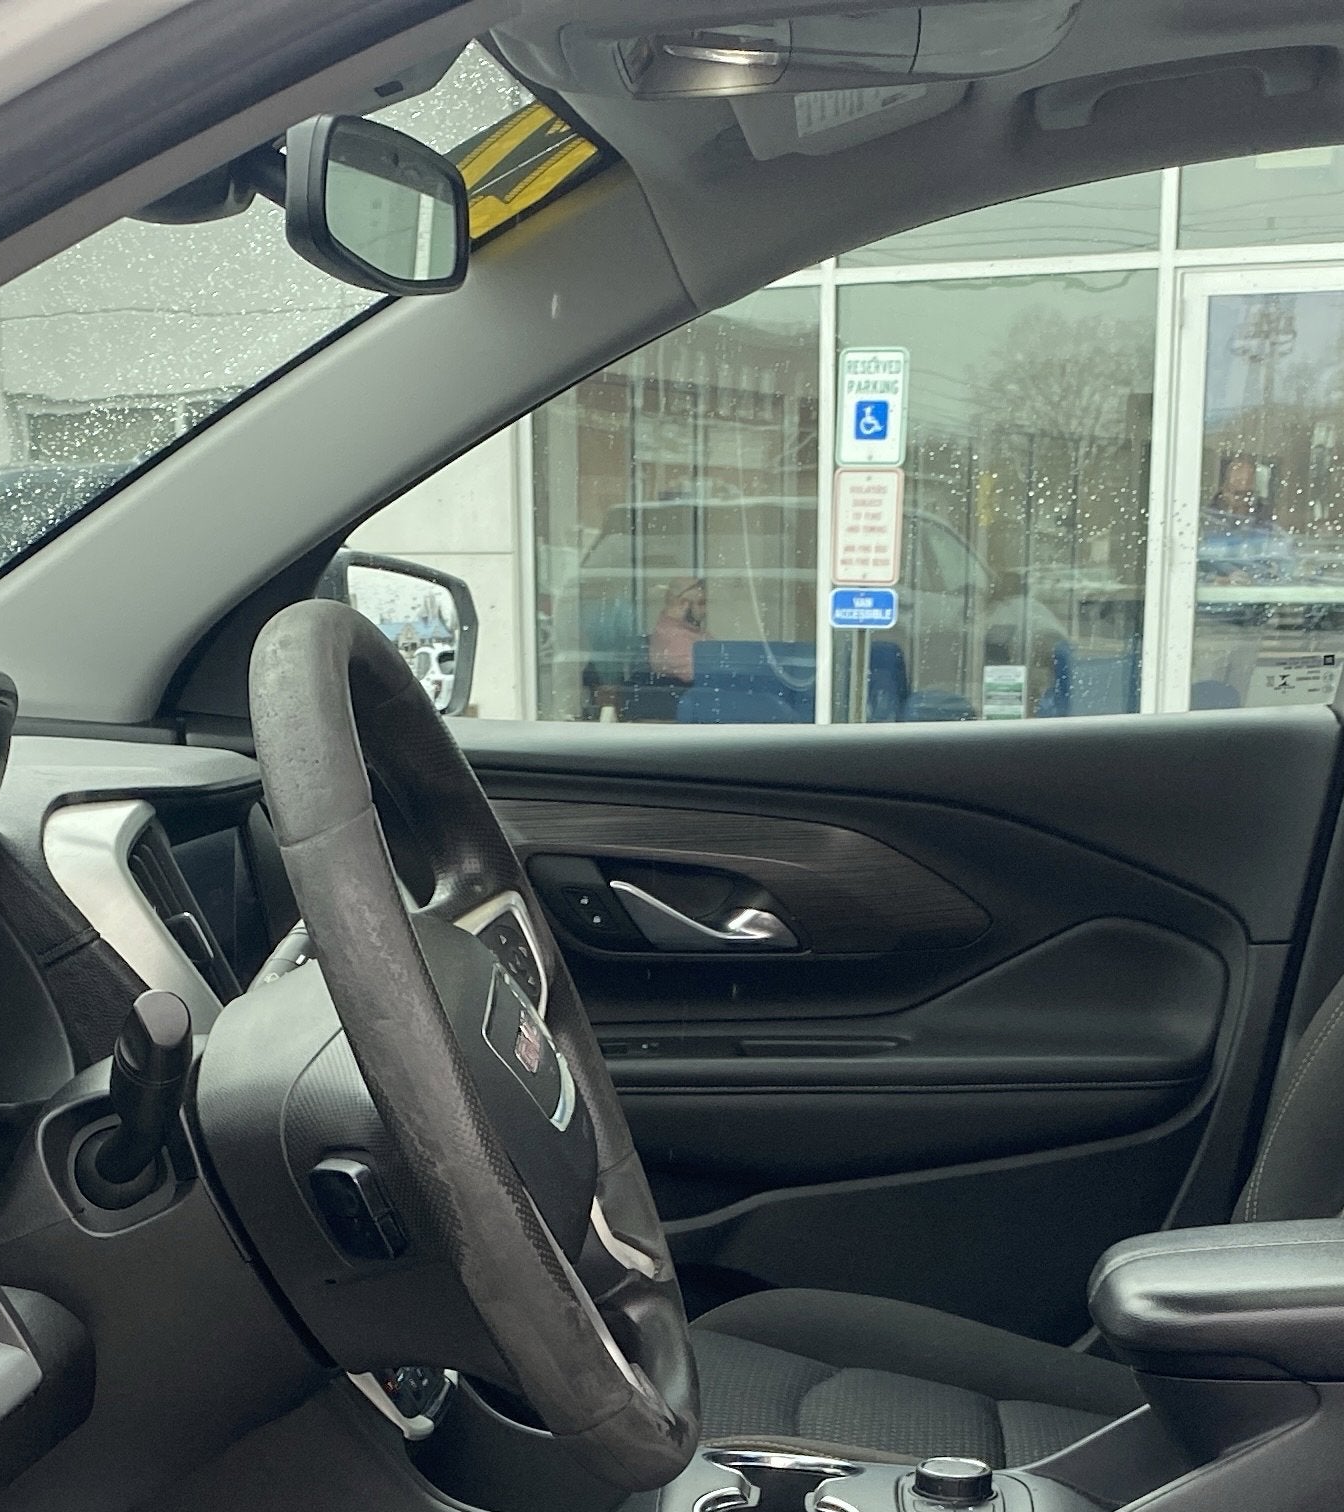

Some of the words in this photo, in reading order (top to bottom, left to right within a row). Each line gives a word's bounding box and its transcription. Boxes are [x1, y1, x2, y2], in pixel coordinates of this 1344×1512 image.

[847, 360, 902, 375] RESERVED
[847, 380, 900, 395] PARKING
[833, 608, 893, 620] ACCESSIBLE
